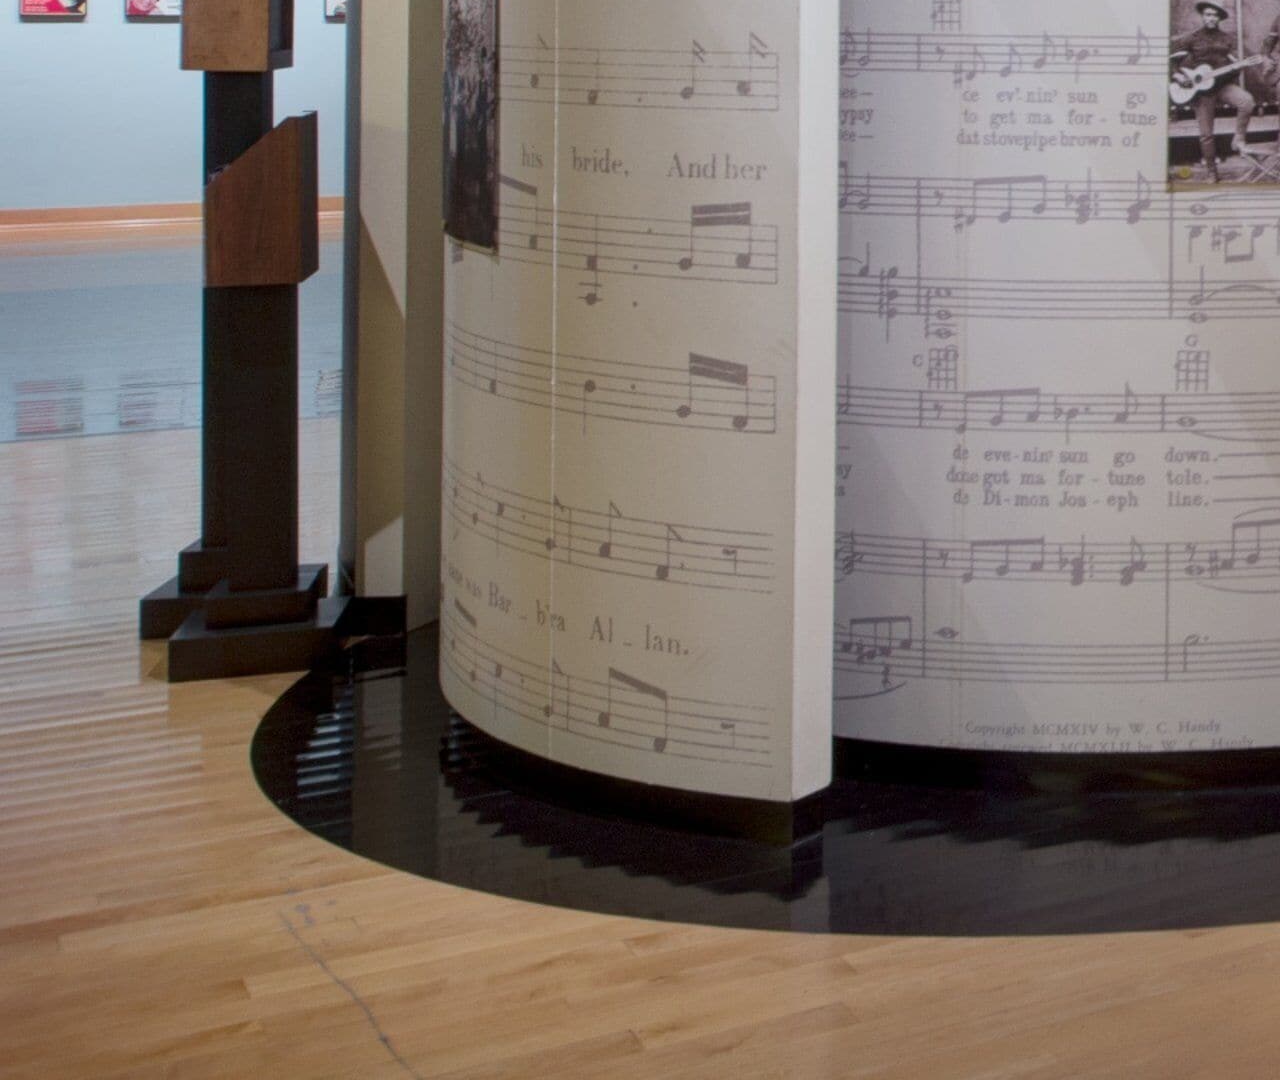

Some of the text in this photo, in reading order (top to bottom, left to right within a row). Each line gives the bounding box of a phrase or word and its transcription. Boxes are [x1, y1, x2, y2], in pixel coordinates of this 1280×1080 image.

[1118, 111, 1158, 127] tune
[1120, 131, 1142, 148] of
[520, 144, 768, 180] his bride, And her
[1112, 449, 1137, 467] go
[1107, 471, 1147, 487] tune
[590, 616, 613, 643] Al
